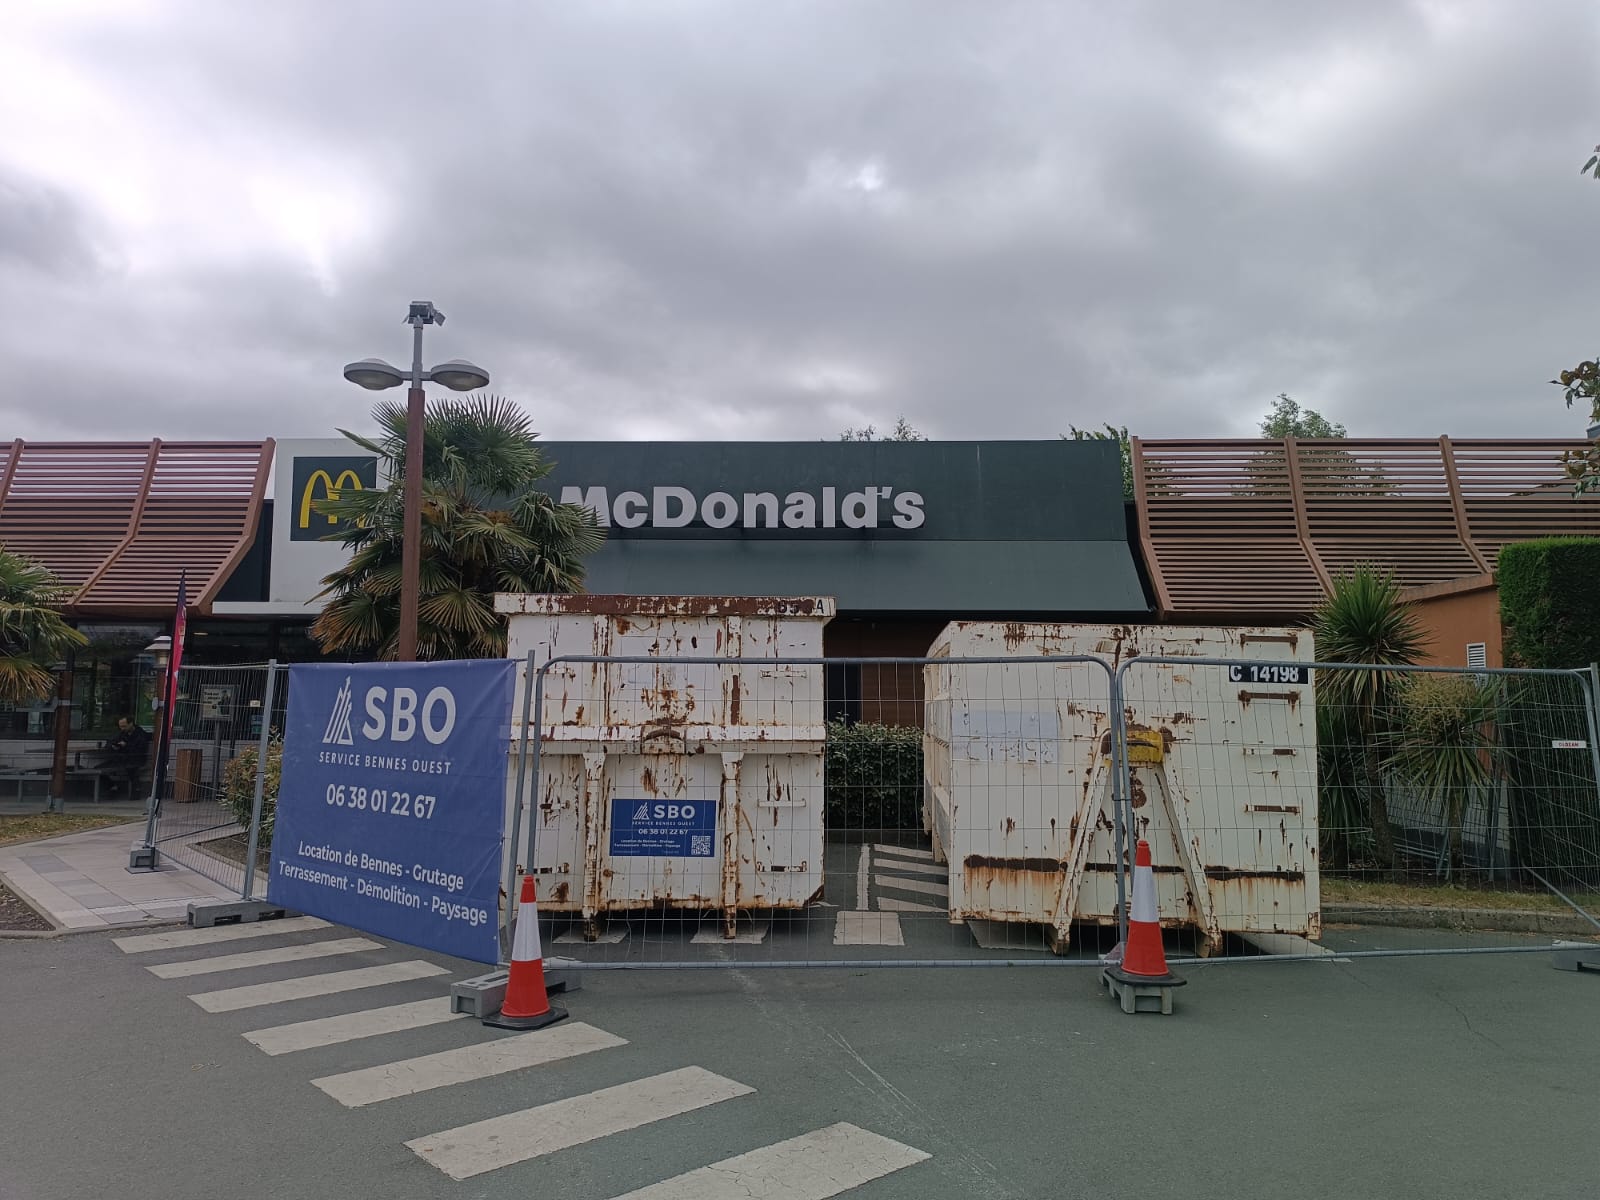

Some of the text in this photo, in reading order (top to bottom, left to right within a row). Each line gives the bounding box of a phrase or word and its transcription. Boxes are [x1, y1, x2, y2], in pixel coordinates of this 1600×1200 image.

[560, 486, 925, 529] McDonald's
[1230, 665, 1299, 682] C 14198
[362, 686, 456, 744] SBO
[319, 751, 451, 775] SERVICE BENNES OUEST
[326, 783, 436, 819] 06 38 01 22 67
[653, 804, 696, 819] SBO
[298, 841, 342, 864] Location
[344, 850, 358, 867] de
[360, 853, 402, 877] Bennes
[412, 863, 464, 893] Grutage
[279, 860, 348, 891] Terrassement
[357, 877, 420, 909] Démolition
[431, 895, 488, 927] Paysage
